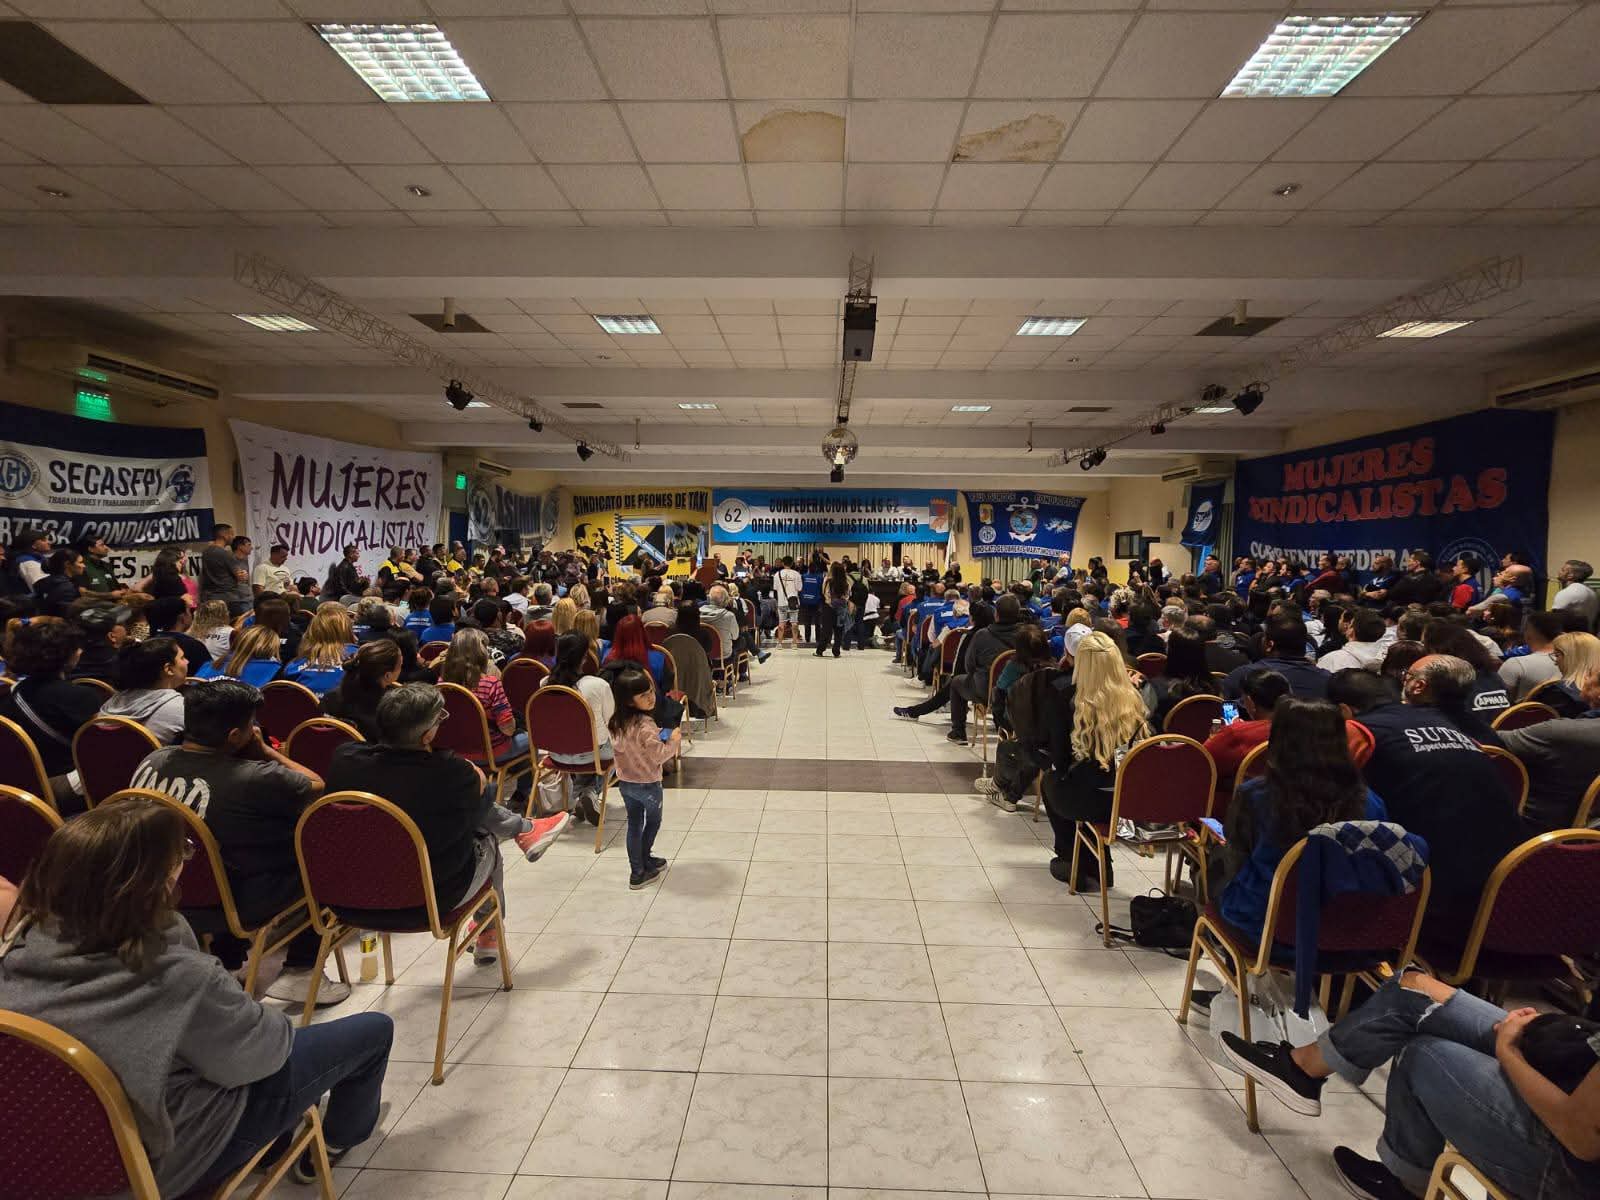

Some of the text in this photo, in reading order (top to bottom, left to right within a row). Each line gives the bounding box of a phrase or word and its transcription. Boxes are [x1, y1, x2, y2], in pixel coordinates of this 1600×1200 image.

[49, 460, 163, 497] SECASFPI
[270, 451, 427, 512] MUJERES
[1283, 438, 1434, 492] MUJERES
[573, 495, 622, 514] SINDICATO
[624, 494, 635, 508] DE
[638, 493, 672, 508] PEONES
[675, 492, 686, 508] DE
[850, 498, 862, 513] DE
[865, 498, 883, 513] LAS
[886, 498, 899, 513] 62
[1249, 468, 1507, 523] SINDICALISTAS
[724, 508, 742, 522] 62
[751, 518, 918, 534] ORGANIZACIONES JUSTICIALISTAS
[275, 519, 425, 556] SINDICALISTAS
